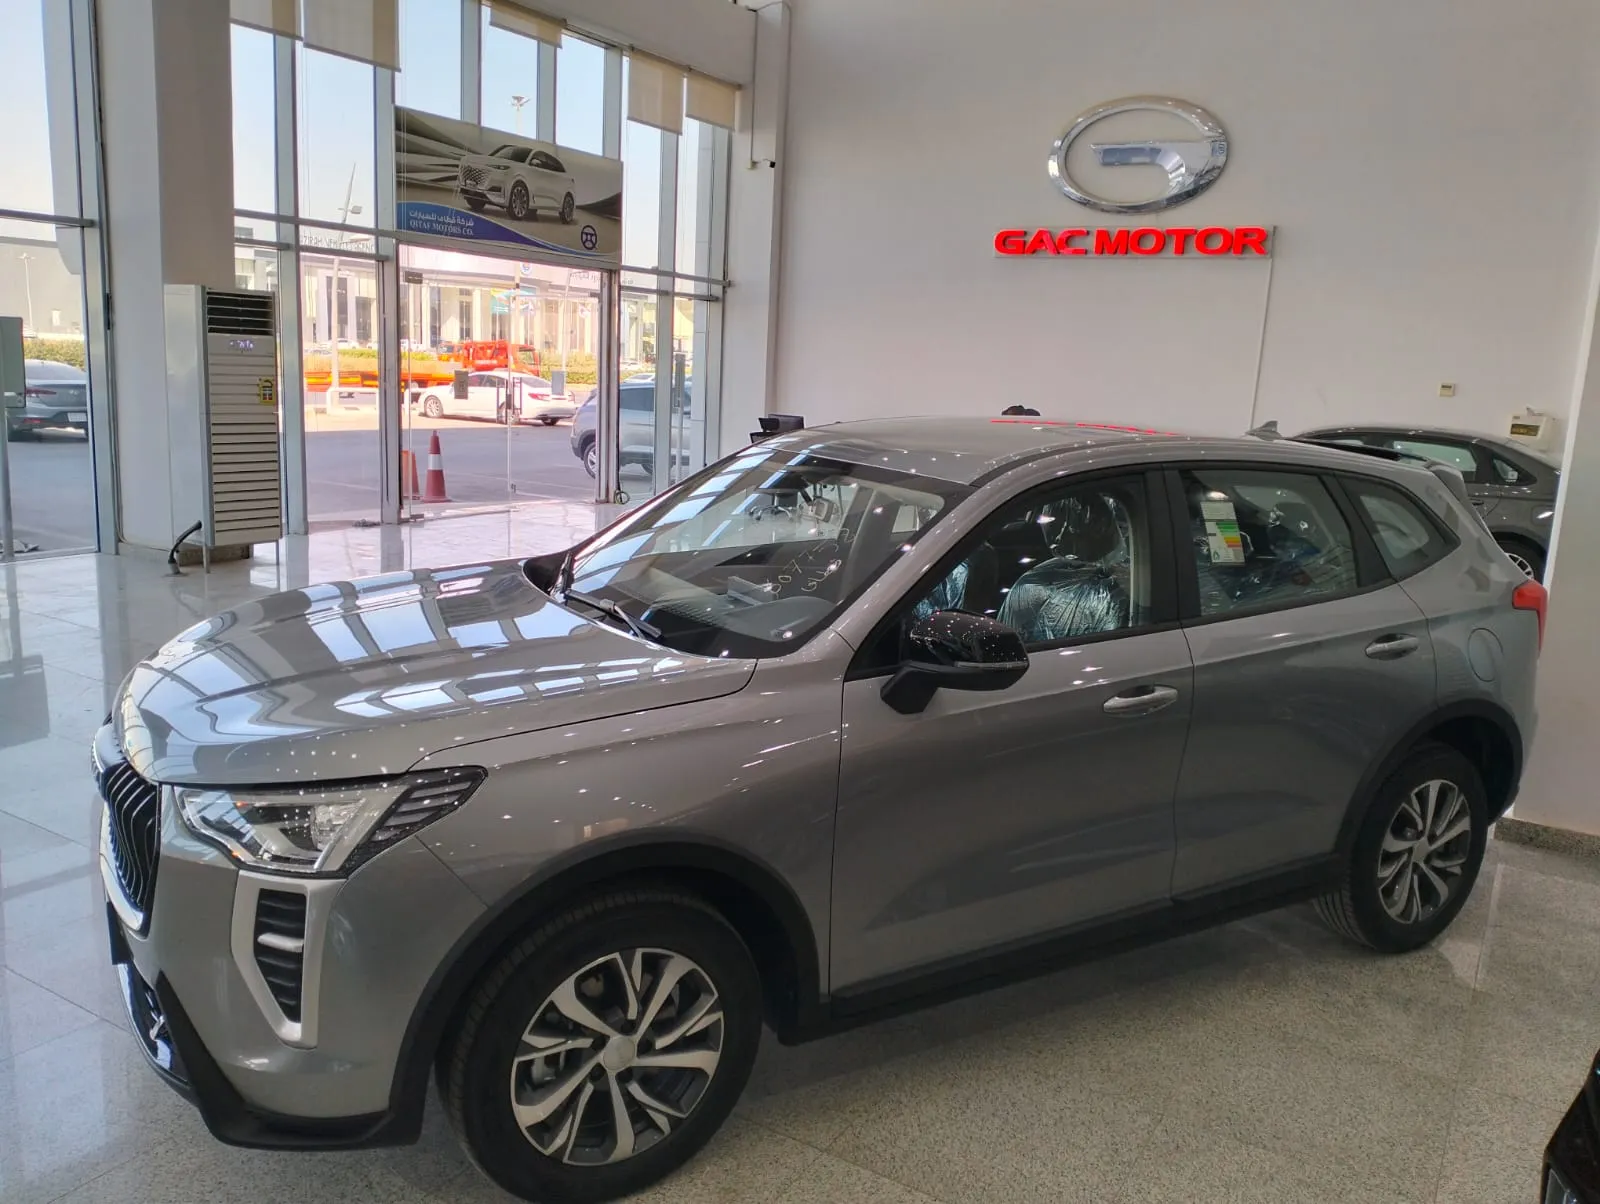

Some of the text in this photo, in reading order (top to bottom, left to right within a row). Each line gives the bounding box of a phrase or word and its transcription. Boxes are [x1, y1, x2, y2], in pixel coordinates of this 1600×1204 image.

[431, 222, 461, 234] MOTORS
[994, 226, 1268, 256] GAC MOTOR
